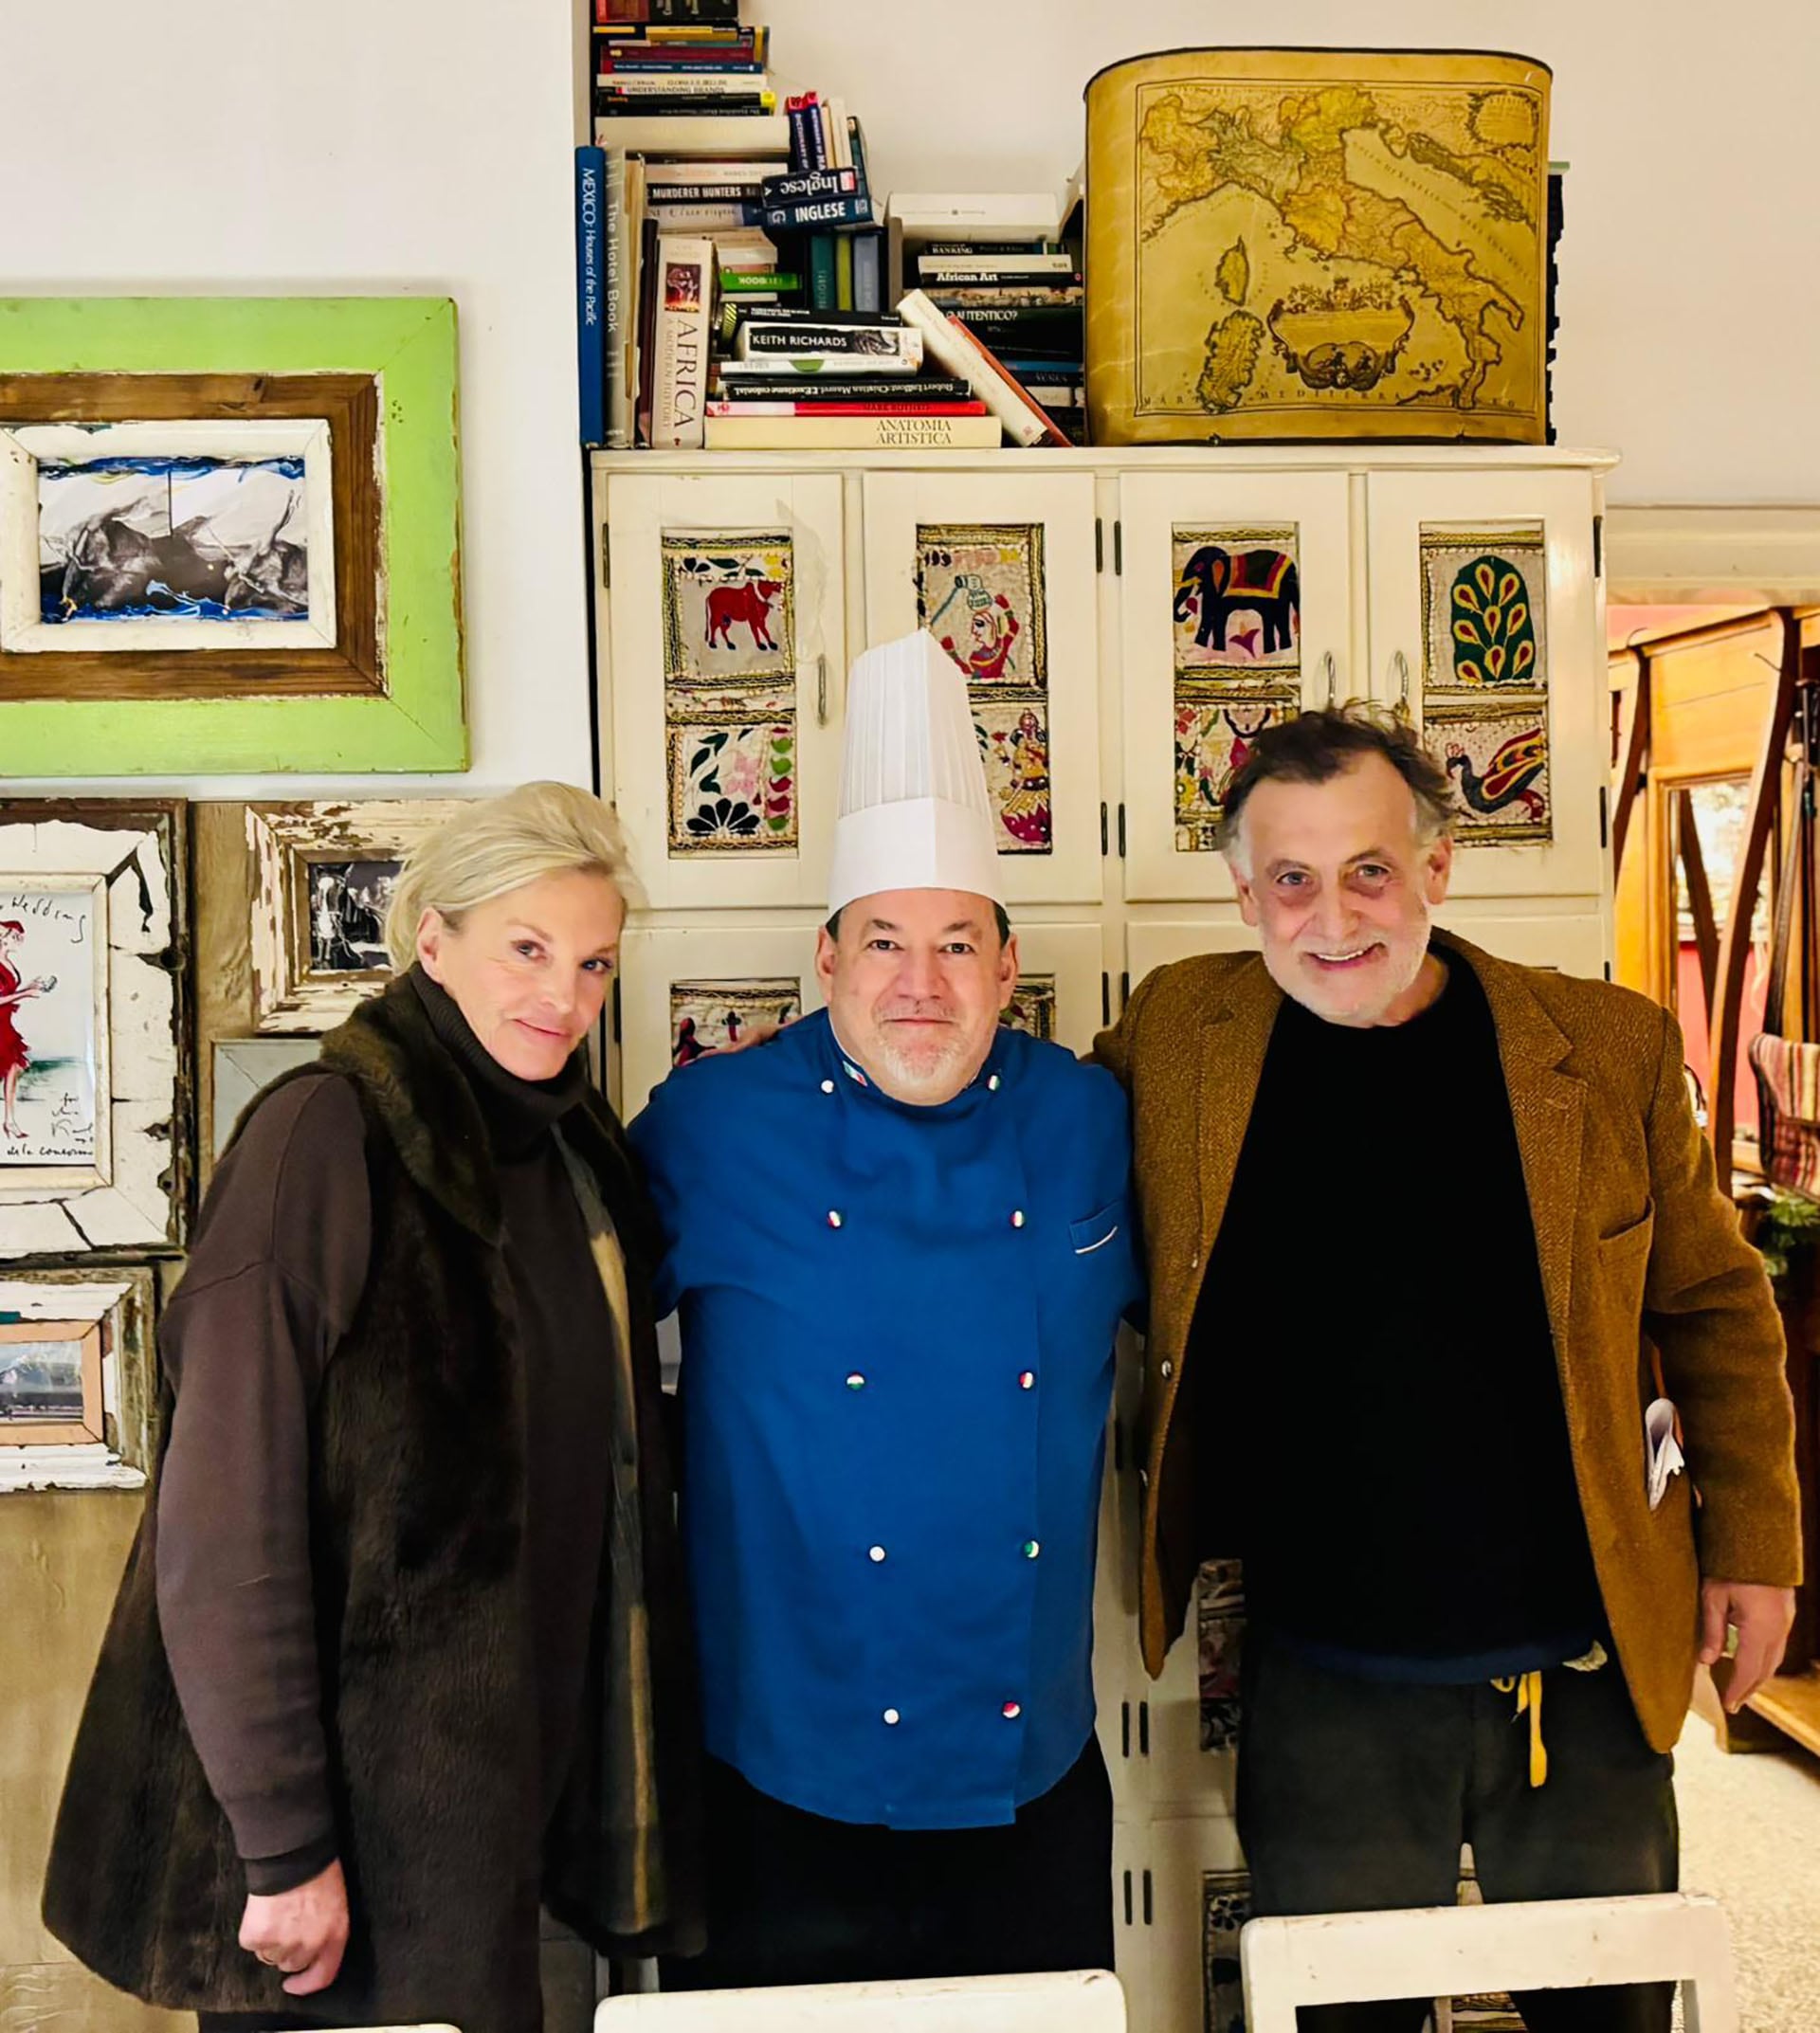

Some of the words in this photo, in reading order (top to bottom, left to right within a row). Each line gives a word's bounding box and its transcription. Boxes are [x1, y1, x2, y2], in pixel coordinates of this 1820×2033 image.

[652, 187, 700, 198] MURDERER
[702, 186, 741, 197] HUNTERS
[779, 172, 838, 196] Inglese
[607, 200, 619, 232] The
[795, 202, 846, 223] INGLESE
[585, 229, 596, 265] Houses
[607, 238, 619, 283] Hotel
[585, 265, 597, 278] of
[937, 271, 978, 281] African
[979, 272, 998, 281] Art
[585, 278, 597, 295] the
[585, 295, 597, 326] Pacific
[607, 289, 619, 332] Book
[752, 335, 786, 345] KEITH
[790, 336, 847, 347] RICHARDS
[674, 318, 698, 427] AFRICA
[877, 419, 952, 431] ANATOMIA
[877, 432, 952, 445] ARTISTICA
